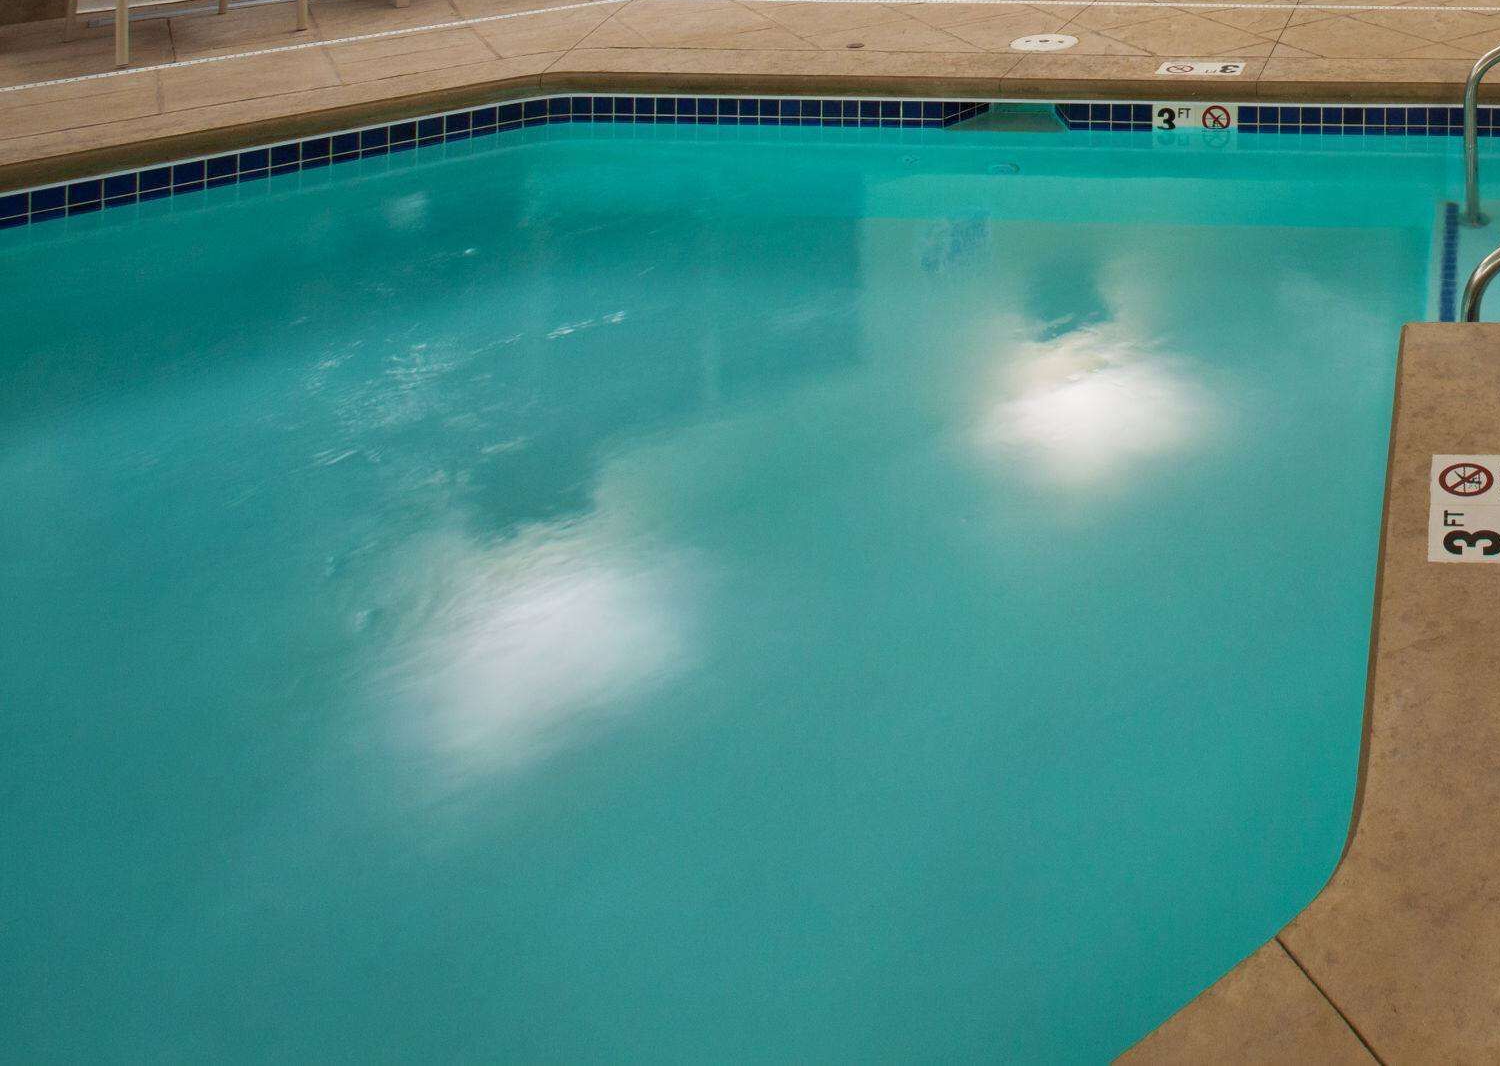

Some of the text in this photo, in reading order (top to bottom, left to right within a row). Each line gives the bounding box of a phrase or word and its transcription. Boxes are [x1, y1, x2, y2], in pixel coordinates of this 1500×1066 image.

[1219, 64, 1240, 74] 3
[1157, 107, 1191, 130] 3 FT
[1443, 509, 1465, 527] FT
